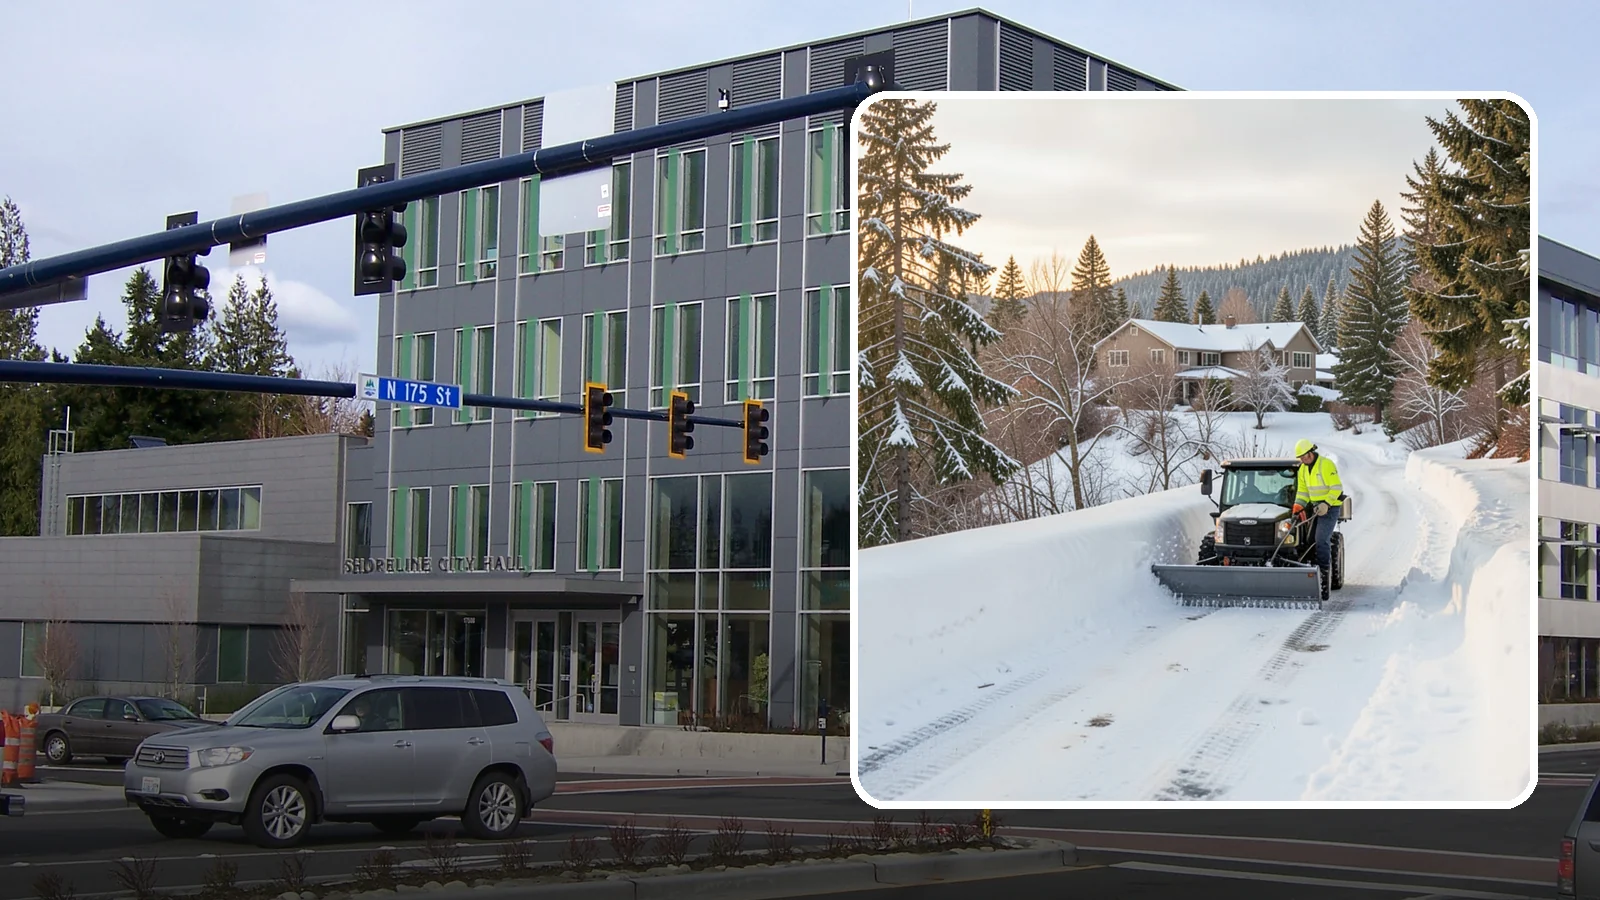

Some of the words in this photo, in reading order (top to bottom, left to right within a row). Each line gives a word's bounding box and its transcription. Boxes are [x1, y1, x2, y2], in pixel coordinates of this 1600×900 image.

[387, 380, 396, 400] N
[405, 382, 427, 403] 175
[436, 386, 451, 406] St
[343, 557, 432, 574] SHORELINE
[438, 556, 476, 572] CITY
[484, 556, 525, 571] HALL
